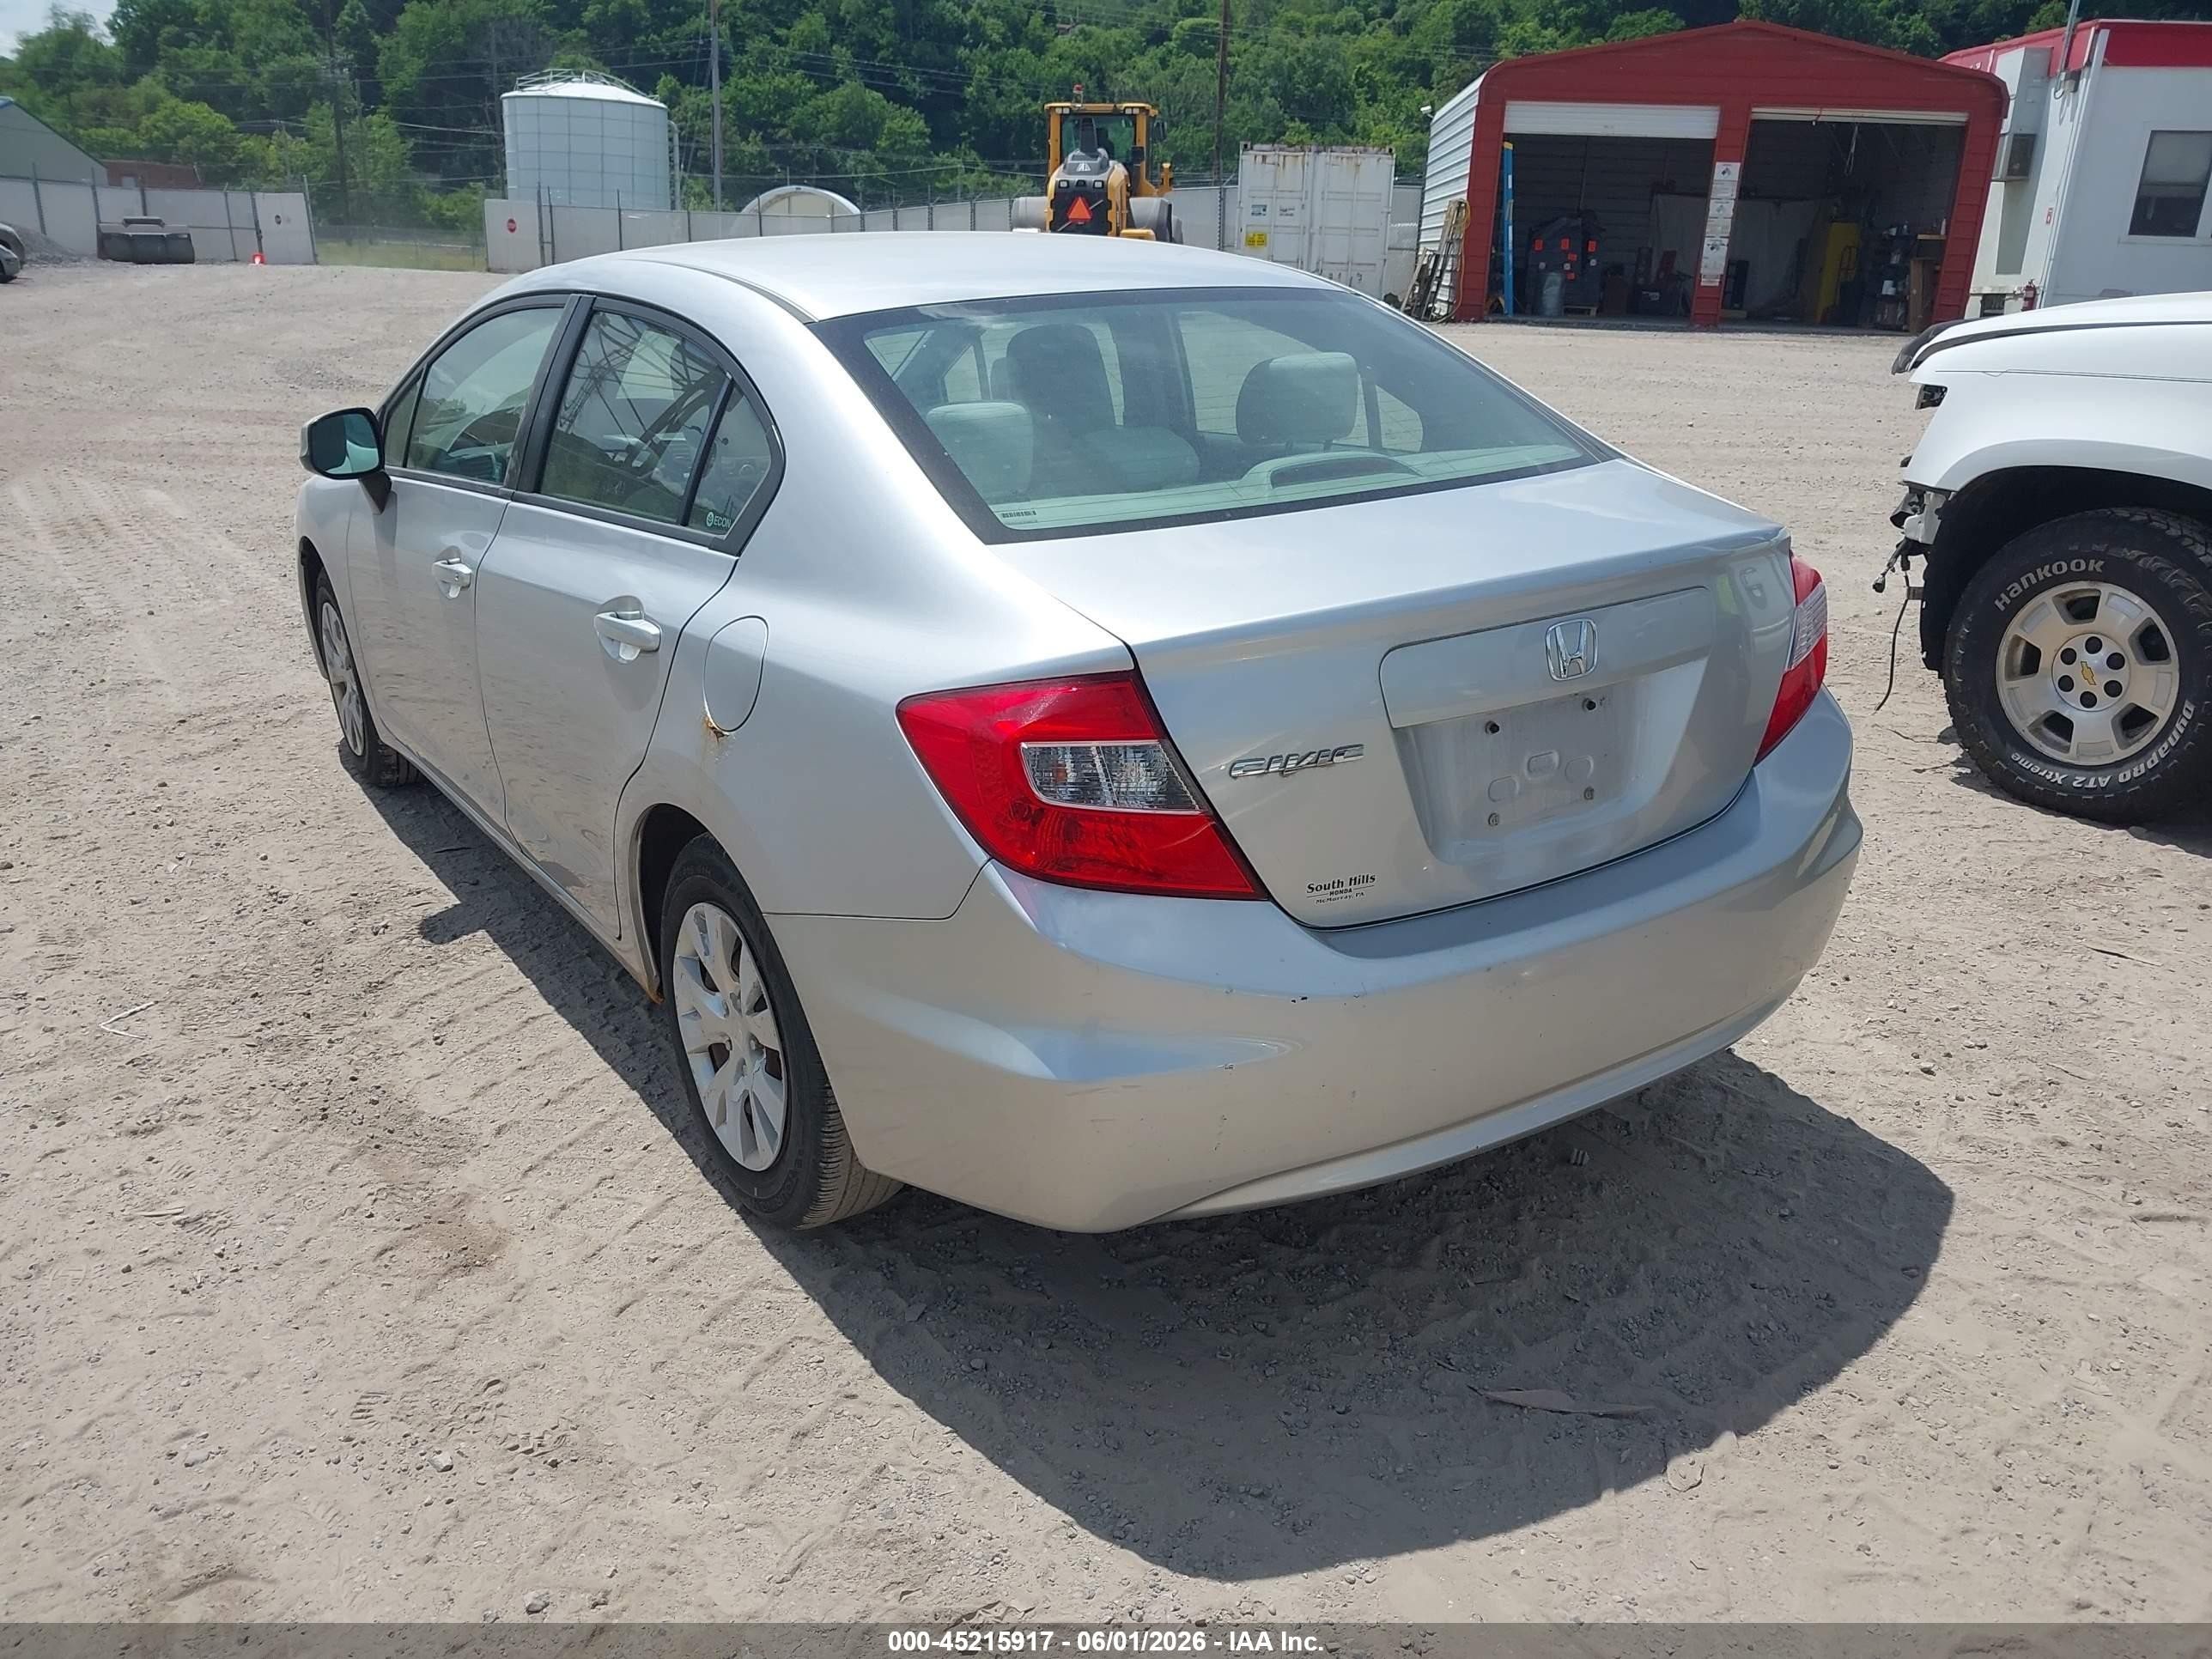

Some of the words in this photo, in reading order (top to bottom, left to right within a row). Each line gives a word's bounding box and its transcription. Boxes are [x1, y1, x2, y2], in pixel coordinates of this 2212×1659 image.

[714, 515, 732, 529] ECON
[1229, 744, 1364, 778] CIVIC
[2072, 775, 2112, 788] AT2
[1306, 878, 1344, 894] South
[1349, 873, 1376, 887] Hills
[1329, 888, 1352, 896] HONDA
